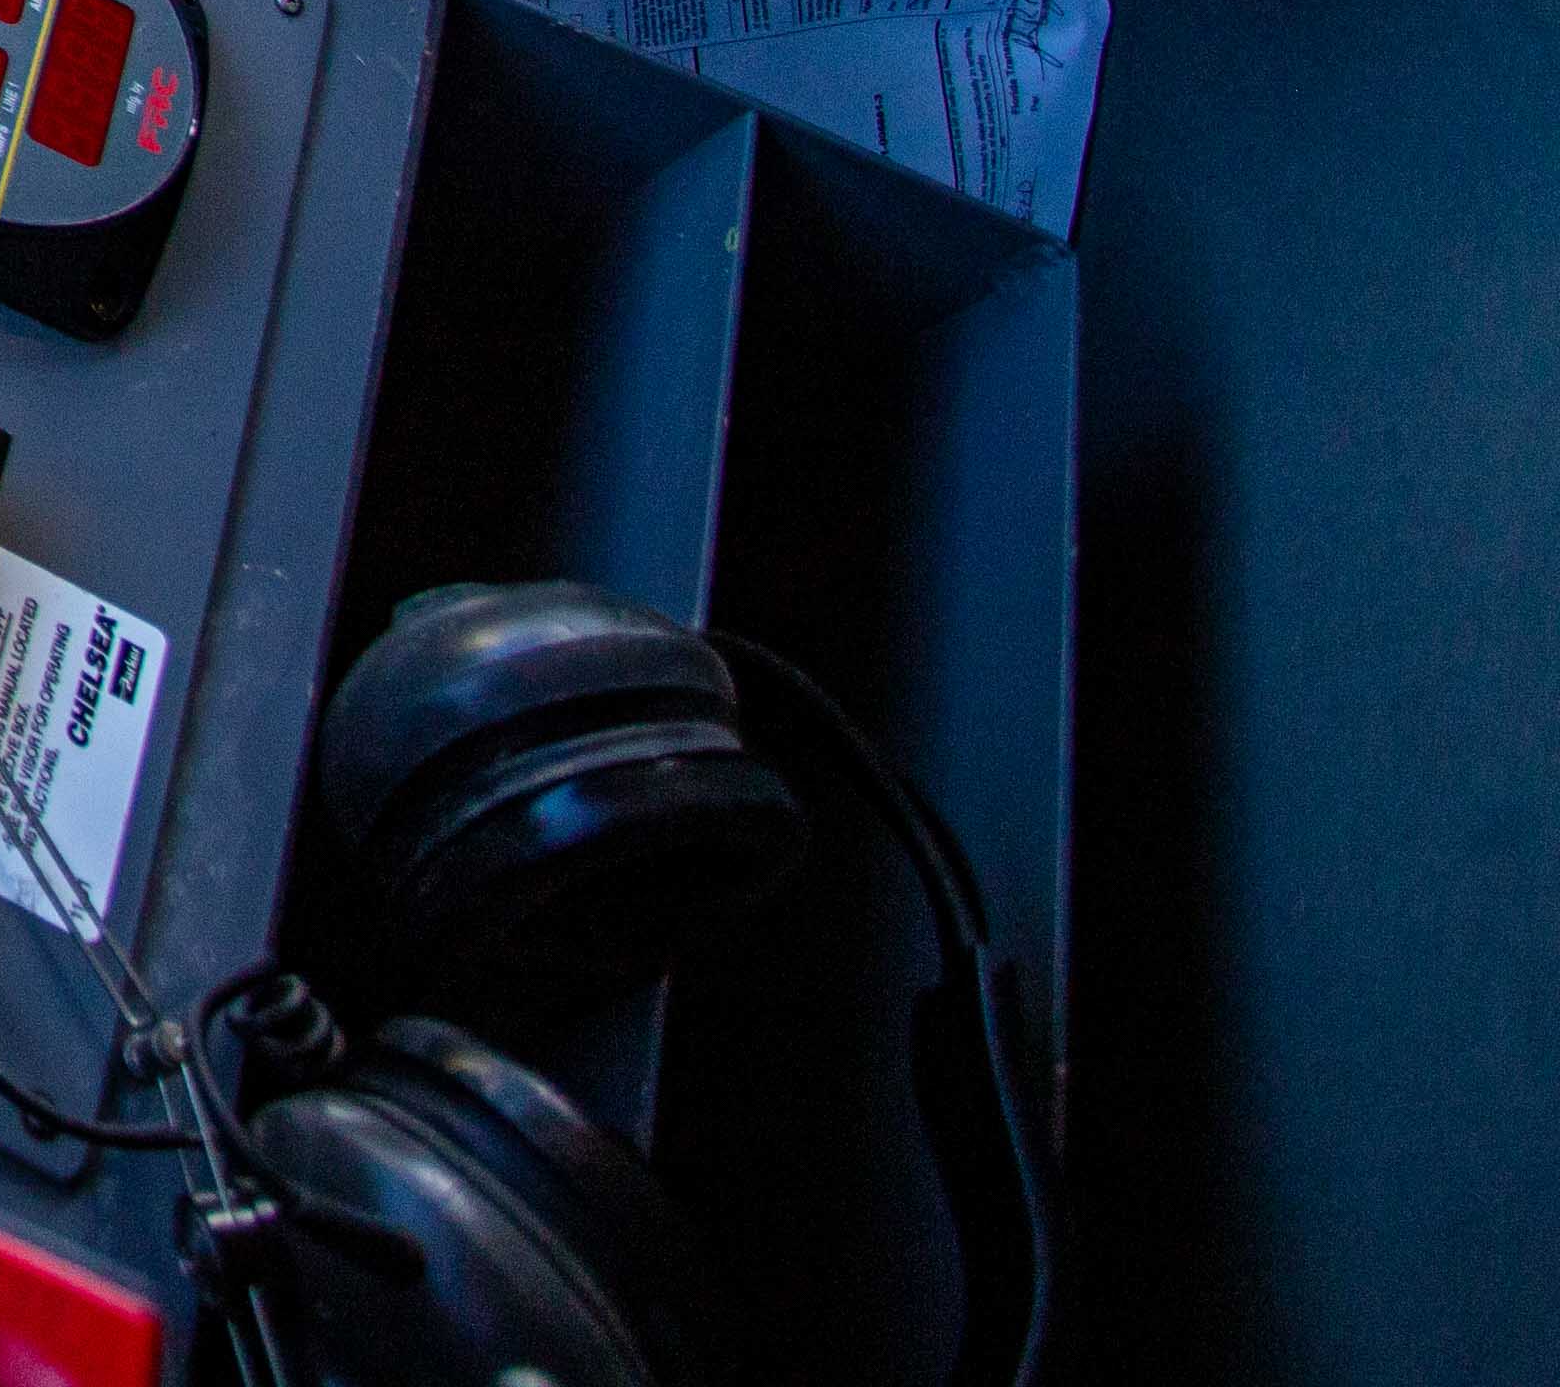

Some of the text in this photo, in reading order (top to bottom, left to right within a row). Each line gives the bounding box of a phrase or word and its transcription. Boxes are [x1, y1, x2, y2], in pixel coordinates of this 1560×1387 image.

[2, 89, 19, 114] LINE
[11, 598, 38, 661] LOCATED
[67, 609, 117, 750] CHELSEA
[20, 625, 71, 780] VISOR FOR OPERATING
